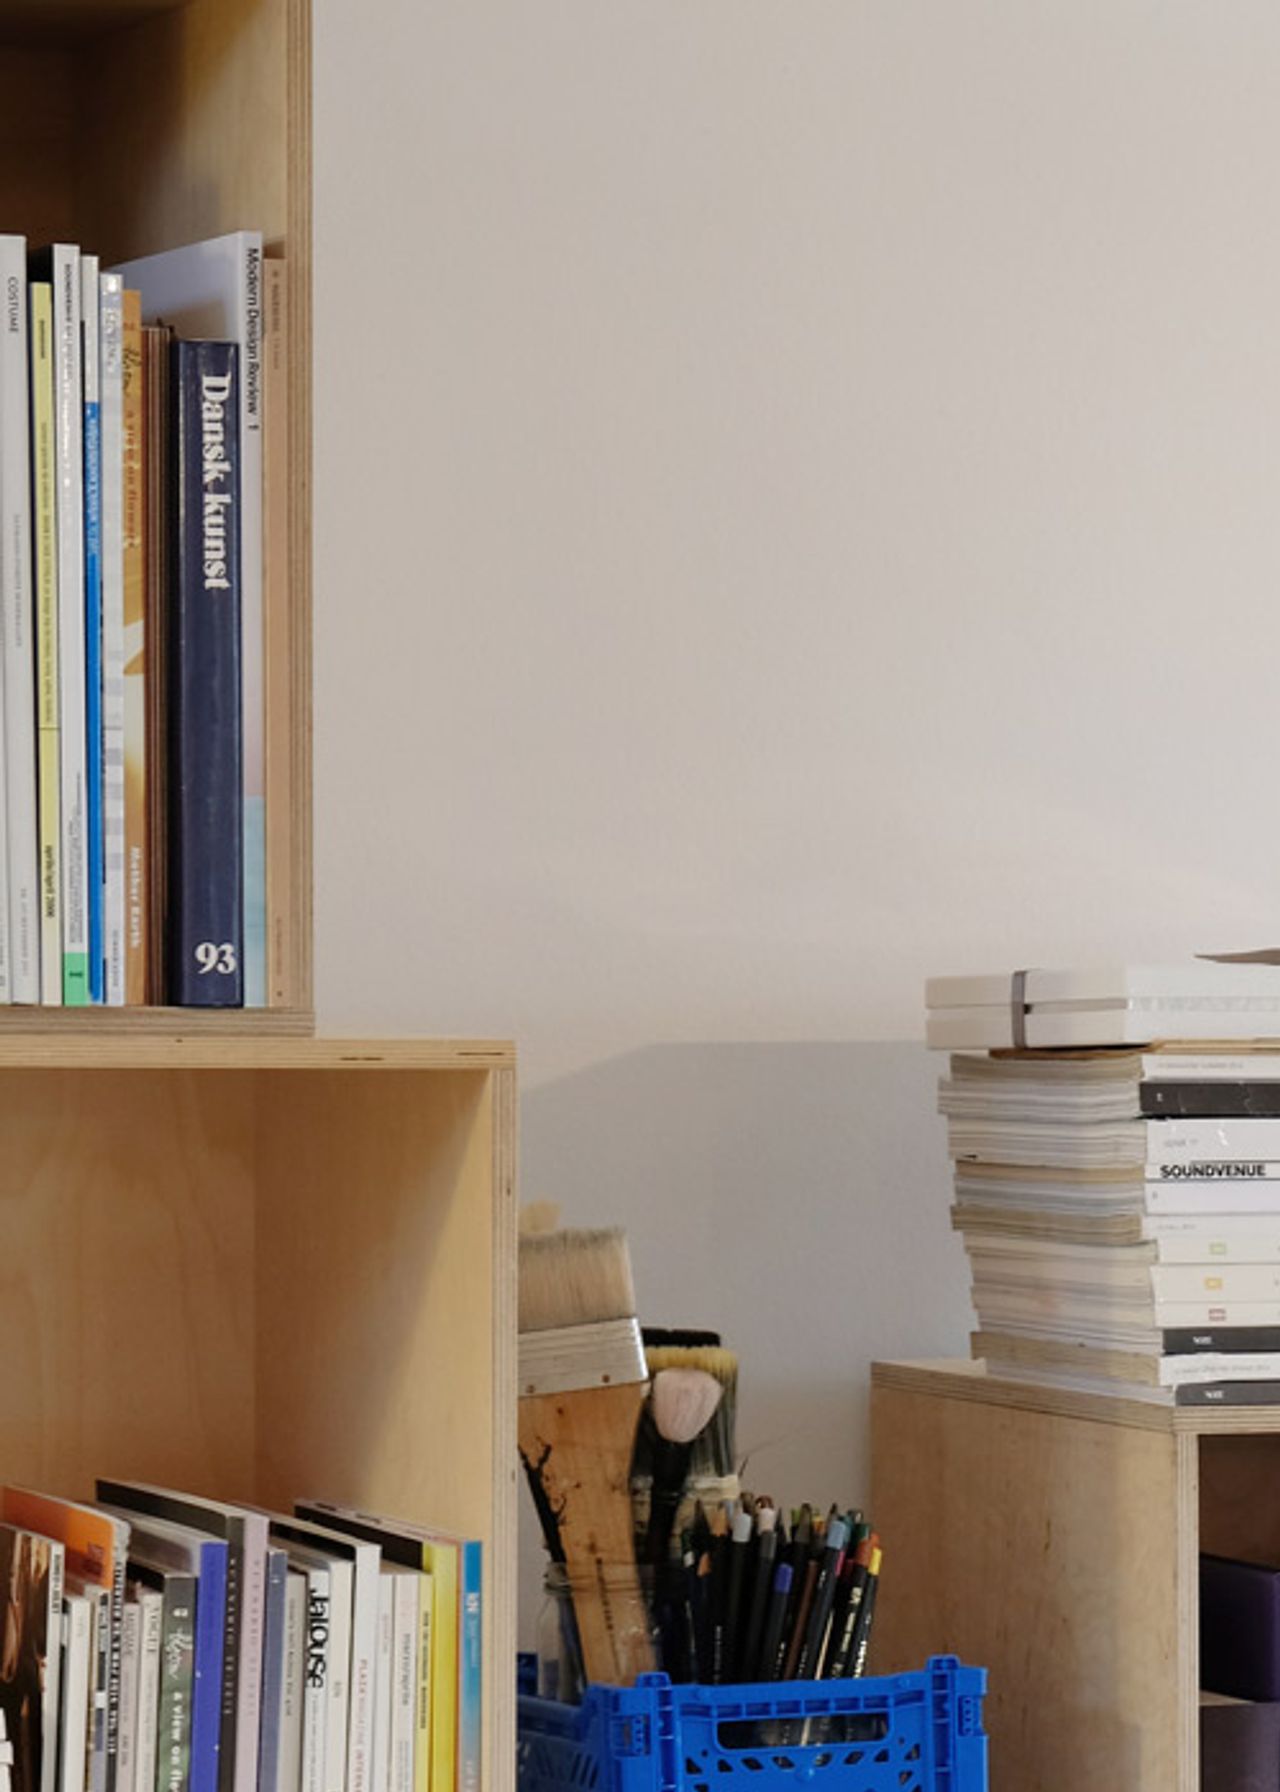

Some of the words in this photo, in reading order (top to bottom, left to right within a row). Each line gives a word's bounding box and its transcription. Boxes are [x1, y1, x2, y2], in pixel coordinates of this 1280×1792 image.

[247, 248, 260, 306] Modern
[6, 277, 19, 334] COSTUME
[245, 309, 260, 359] Design
[246, 361, 260, 416] Review
[201, 374, 232, 484] Dansk
[203, 493, 232, 591] kunst
[194, 942, 236, 975] 93
[1160, 1164, 1266, 1179] SOUNDVENUE
[308, 1587, 330, 1689] Jalouse
[172, 1747, 181, 1765] on
